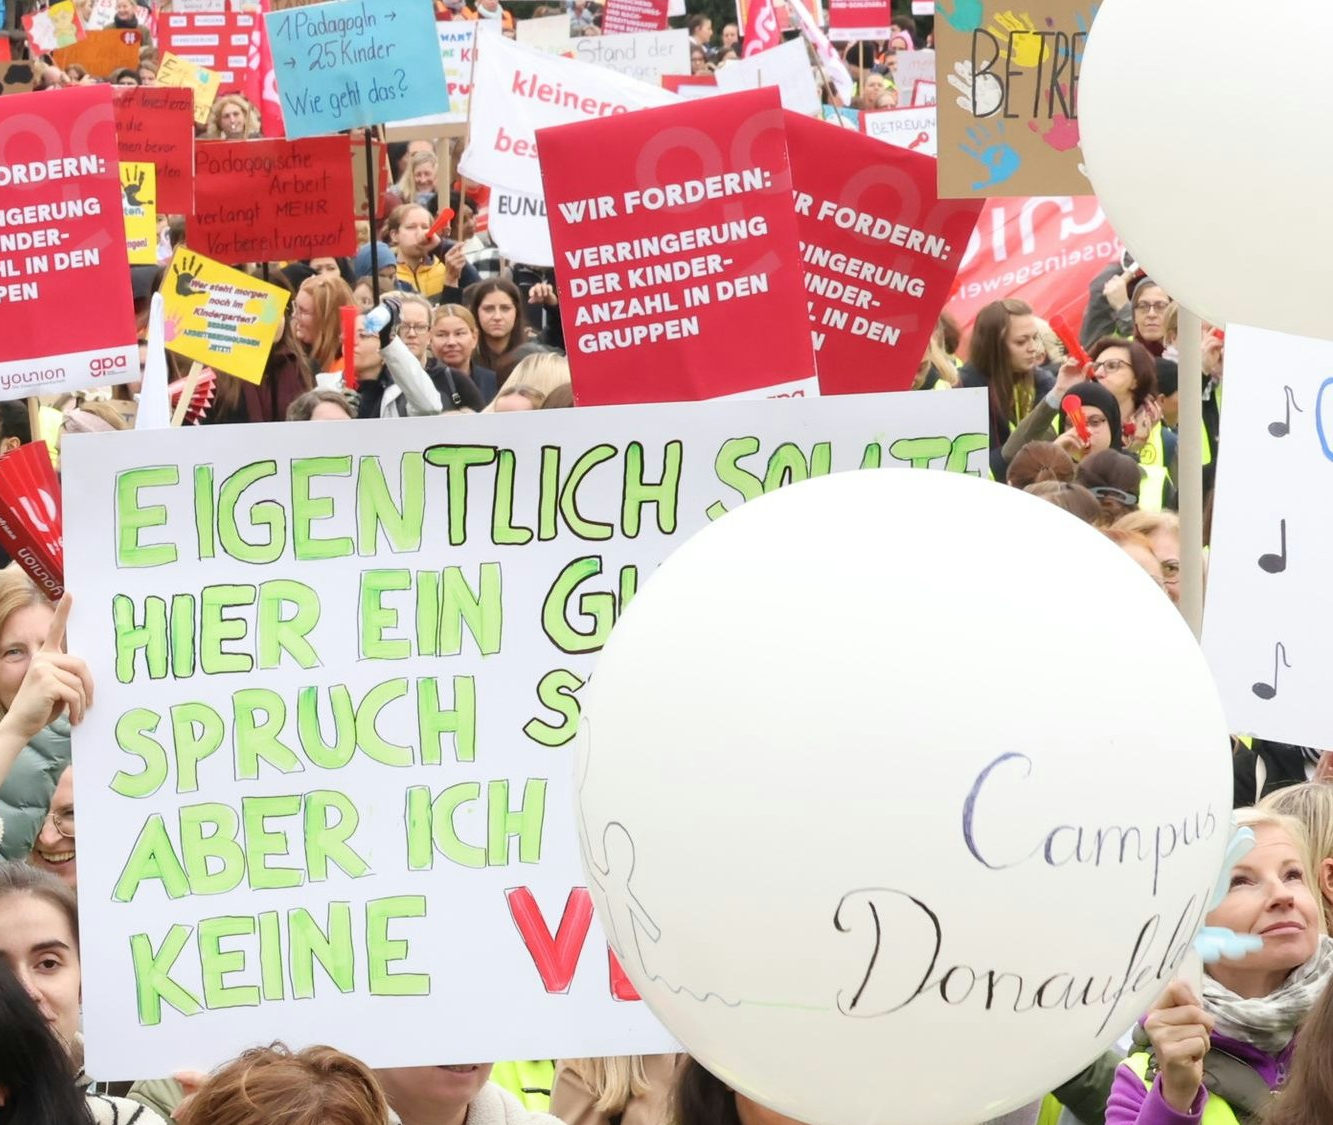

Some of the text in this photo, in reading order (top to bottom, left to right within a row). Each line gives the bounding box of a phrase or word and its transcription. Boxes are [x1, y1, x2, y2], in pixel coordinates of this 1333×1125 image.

[309, 36, 397, 71] 25 Kinder
[576, 36, 675, 63] Stand der
[285, 68, 409, 119] Wie geht das?
[269, 170, 331, 196] Arbeit
[276, 200, 329, 217] MEHR
[558, 166, 773, 225] WIR FORDERN:
[564, 215, 769, 271] VERRINGERUNG
[816, 199, 952, 261] FORDERN:
[25, 256, 50, 276] IN
[54, 247, 101, 272] DEN
[569, 254, 734, 299] DER KINDER-
[574, 271, 770, 328] ANZAHL IN DEN
[821, 304, 901, 348] IN DEN
[577, 315, 700, 355] GRUPPEN
[0, 367, 67, 391] younion
[89, 354, 126, 378] gpa
[114, 438, 686, 569] EIGENTLICH
[112, 561, 504, 685] HIER EIN
[110, 674, 476, 799] SPRUCH
[111, 776, 549, 904] ABER ICH
[961, 751, 1217, 897] Campus
[131, 894, 432, 1027] KEINE
